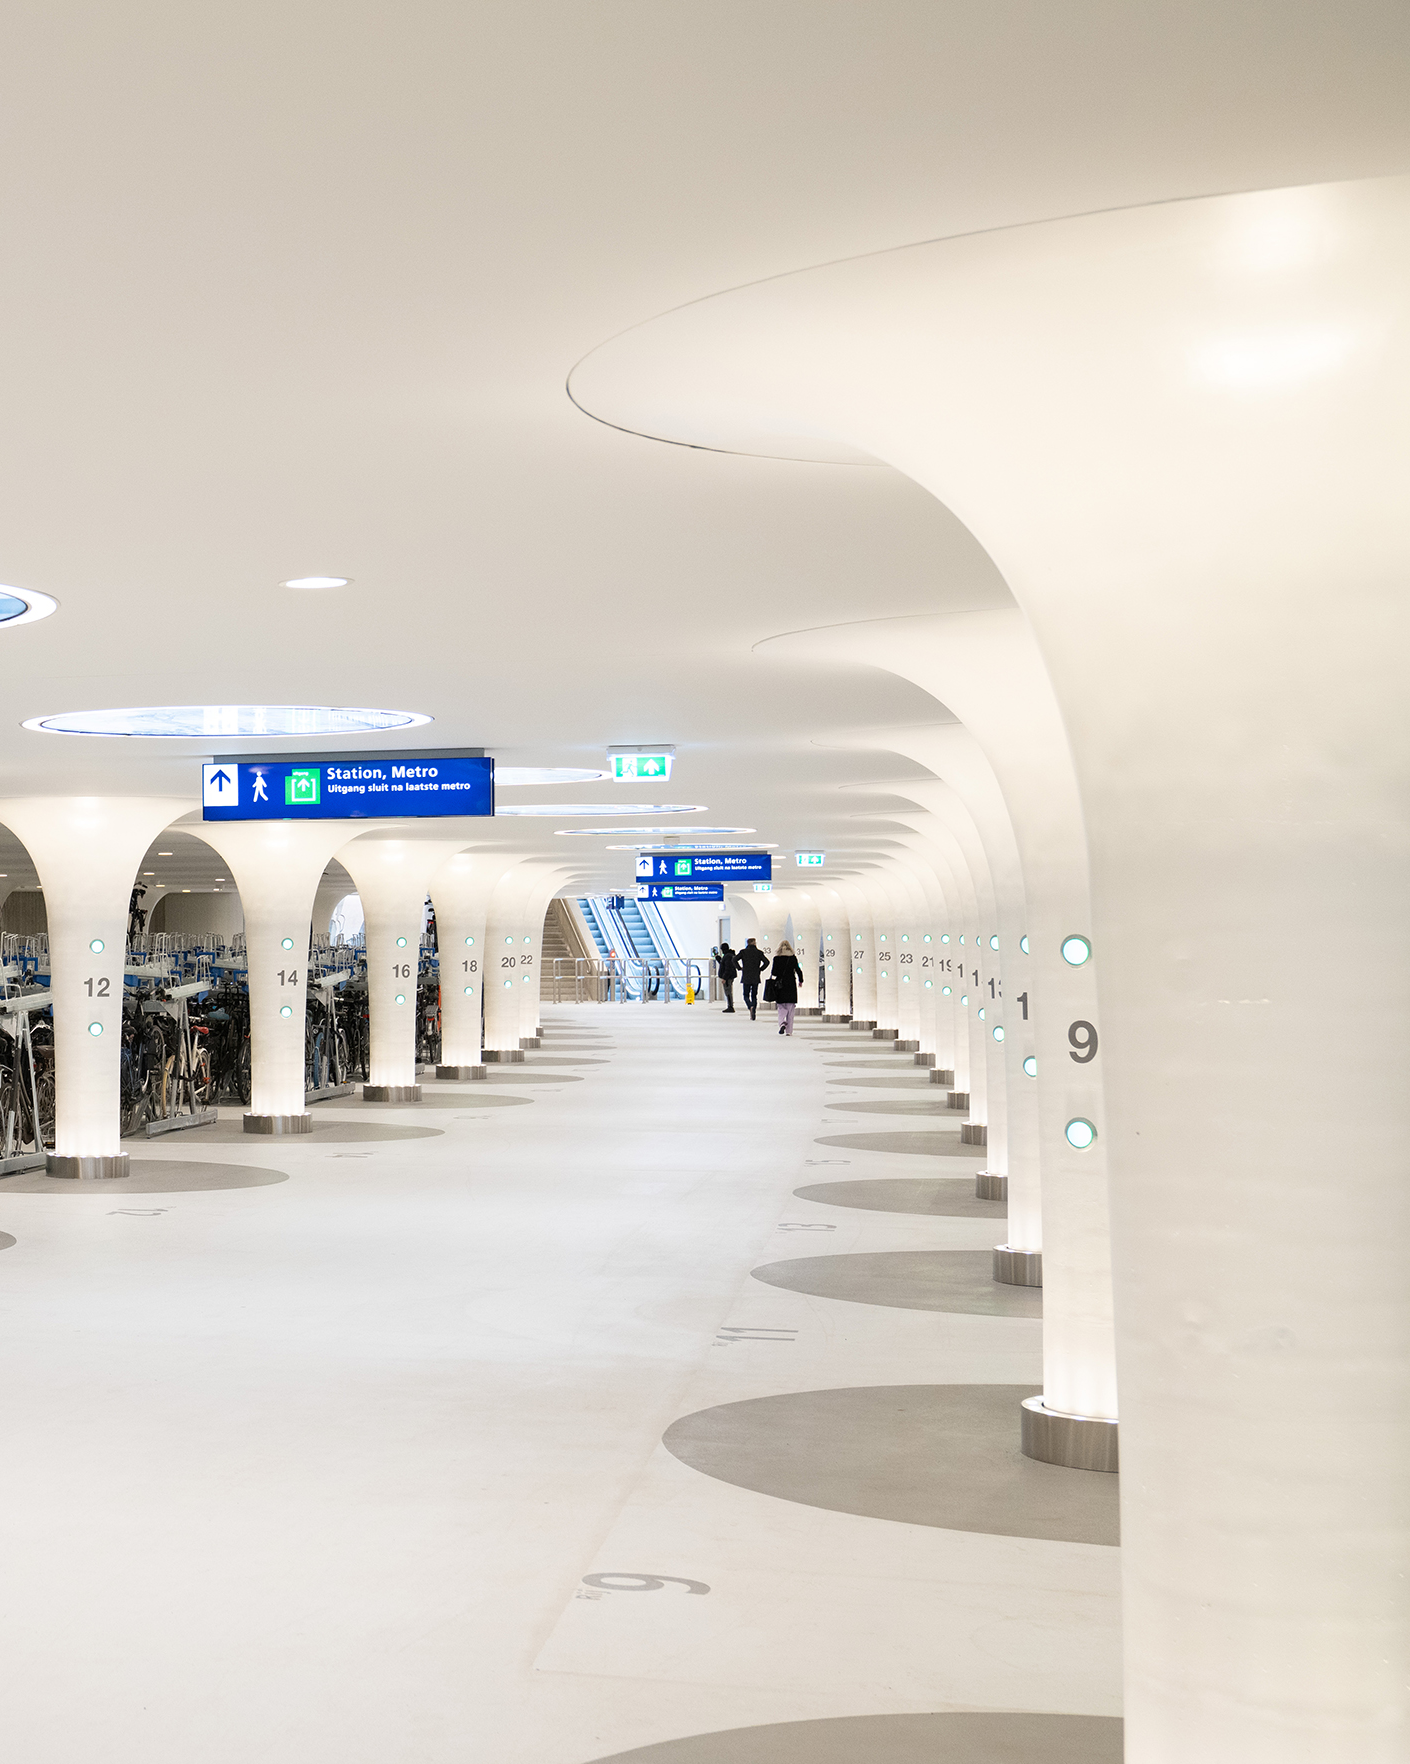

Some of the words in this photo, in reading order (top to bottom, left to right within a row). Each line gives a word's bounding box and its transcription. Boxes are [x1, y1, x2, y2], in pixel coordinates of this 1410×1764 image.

[326, 766, 387, 781] Station,
[391, 765, 438, 779] Metro
[327, 784, 366, 795] Uitgang
[367, 782, 389, 793] sluit
[391, 784, 404, 792] na
[405, 782, 439, 792] laatste
[441, 782, 471, 791] metro
[694, 857, 723, 866] Station,
[724, 857, 747, 865] Metro
[796, 948, 805, 956] 31
[825, 949, 836, 957] 29
[854, 950, 865, 959] 27
[878, 951, 892, 962] 25
[900, 953, 913, 964] 23
[461, 959, 478, 973] 18
[501, 956, 516, 968] 20
[520, 954, 533, 965] 22
[922, 956, 934, 968] 21
[392, 963, 411, 979] 16
[957, 963, 963, 978] 1
[276, 969, 299, 987] 14
[972, 969, 978, 987] 1
[83, 977, 111, 998] 12
[1016, 992, 1028, 1021] 1
[1067, 1020, 1099, 1064] 9
[581, 1572, 711, 1596] 9
